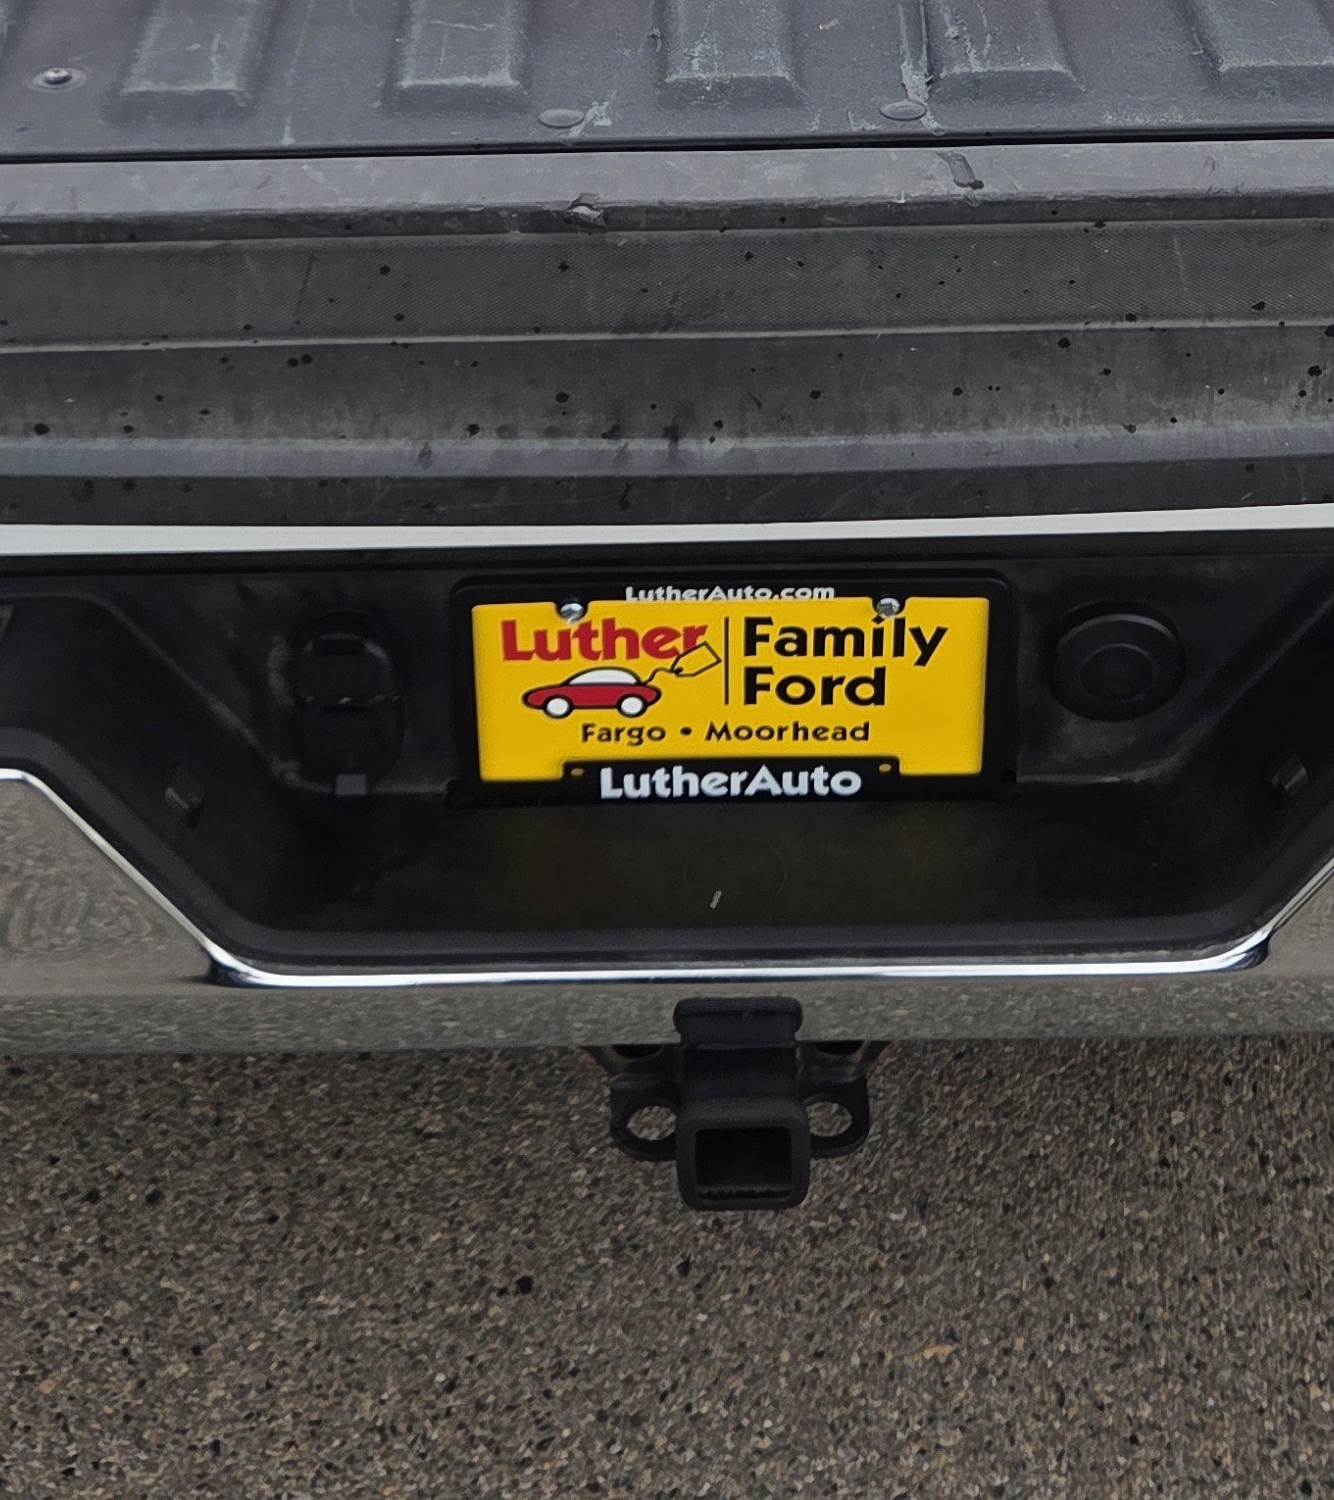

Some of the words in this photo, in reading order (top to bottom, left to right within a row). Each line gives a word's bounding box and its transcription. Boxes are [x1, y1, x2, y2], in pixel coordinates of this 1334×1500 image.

[625, 585, 836, 602] LutherAuto.com
[501, 617, 708, 662] Luther
[744, 615, 948, 667] Family
[744, 665, 886, 706] Ford
[581, 722, 666, 746] Fargo
[704, 720, 870, 742] Moorhead
[600, 764, 863, 800] LutherAuto
